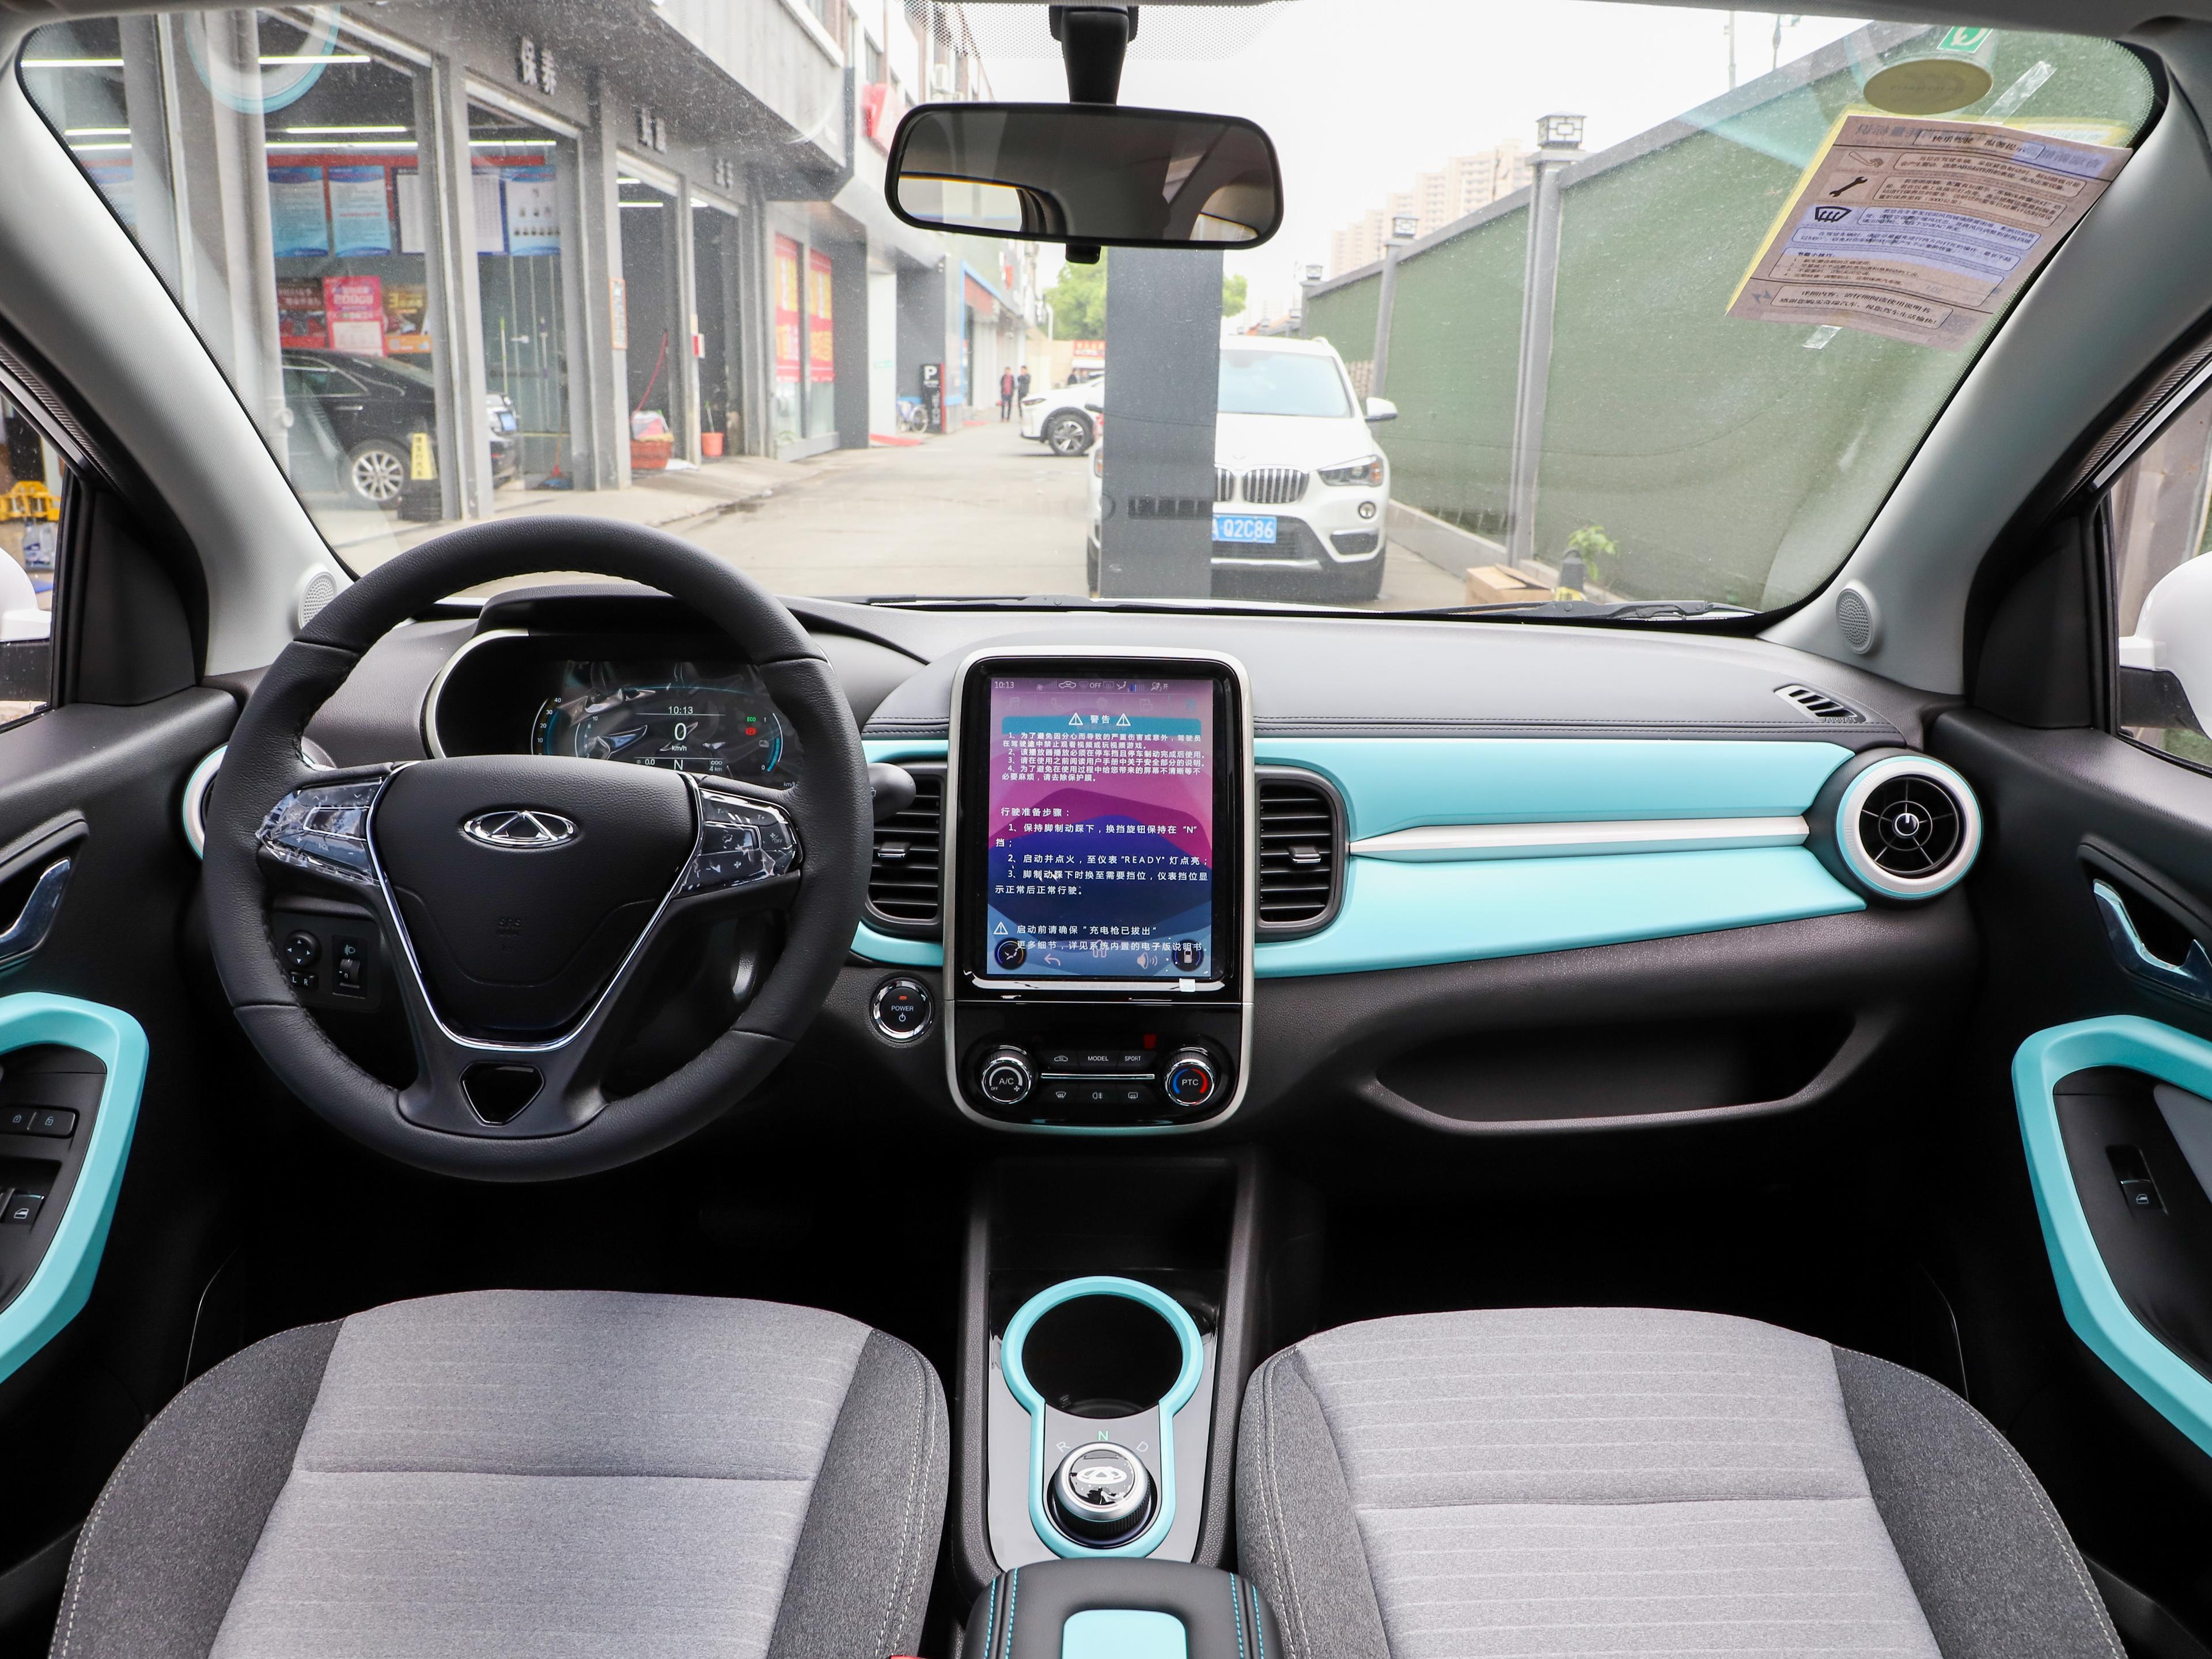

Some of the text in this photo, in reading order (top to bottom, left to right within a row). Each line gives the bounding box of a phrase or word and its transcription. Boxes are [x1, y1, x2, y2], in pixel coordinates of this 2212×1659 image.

[1932, 135, 1974, 144] 快乐驾驶
[924, 365, 937, 380] P
[668, 706, 693, 714] 10:13
[1090, 714, 1111, 725] 警告
[674, 722, 687, 741] 0
[674, 759, 683, 770] N
[1098, 1430, 1108, 1441] N
[1056, 1441, 1071, 1453] R
[1136, 1441, 1149, 1452] D
